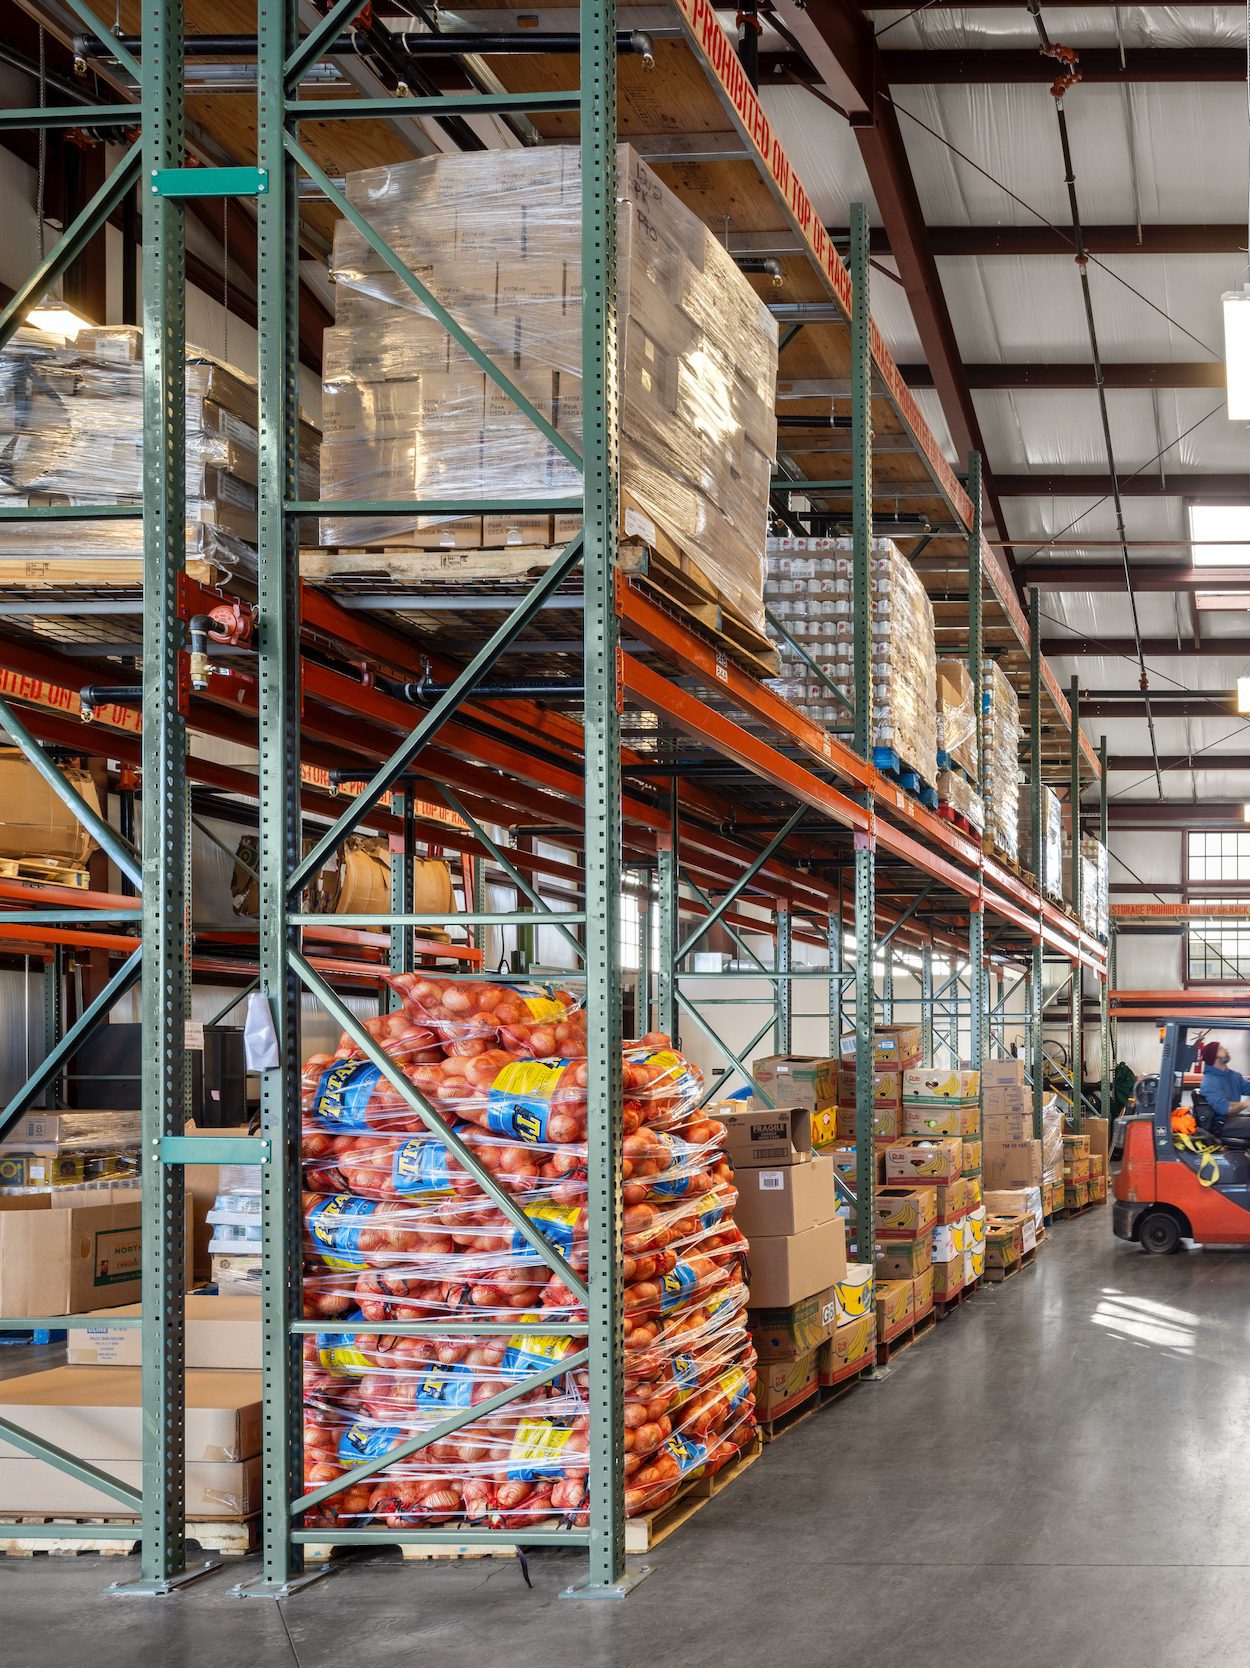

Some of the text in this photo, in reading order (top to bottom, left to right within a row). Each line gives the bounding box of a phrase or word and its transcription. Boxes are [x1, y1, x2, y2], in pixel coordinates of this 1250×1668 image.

[693, 0, 852, 312] PROHIBITED ON TOP OF RACK
[48, 684, 72, 709] ON
[1112, 904, 1145, 915] STORAGE
[1147, 904, 1188, 915] PROHIBITED
[1200, 904, 1216, 915] TOP
[1229, 904, 1249, 915] RACK
[753, 1125, 785, 1133] FRAGILE
[824, 1305, 835, 1323] G6
